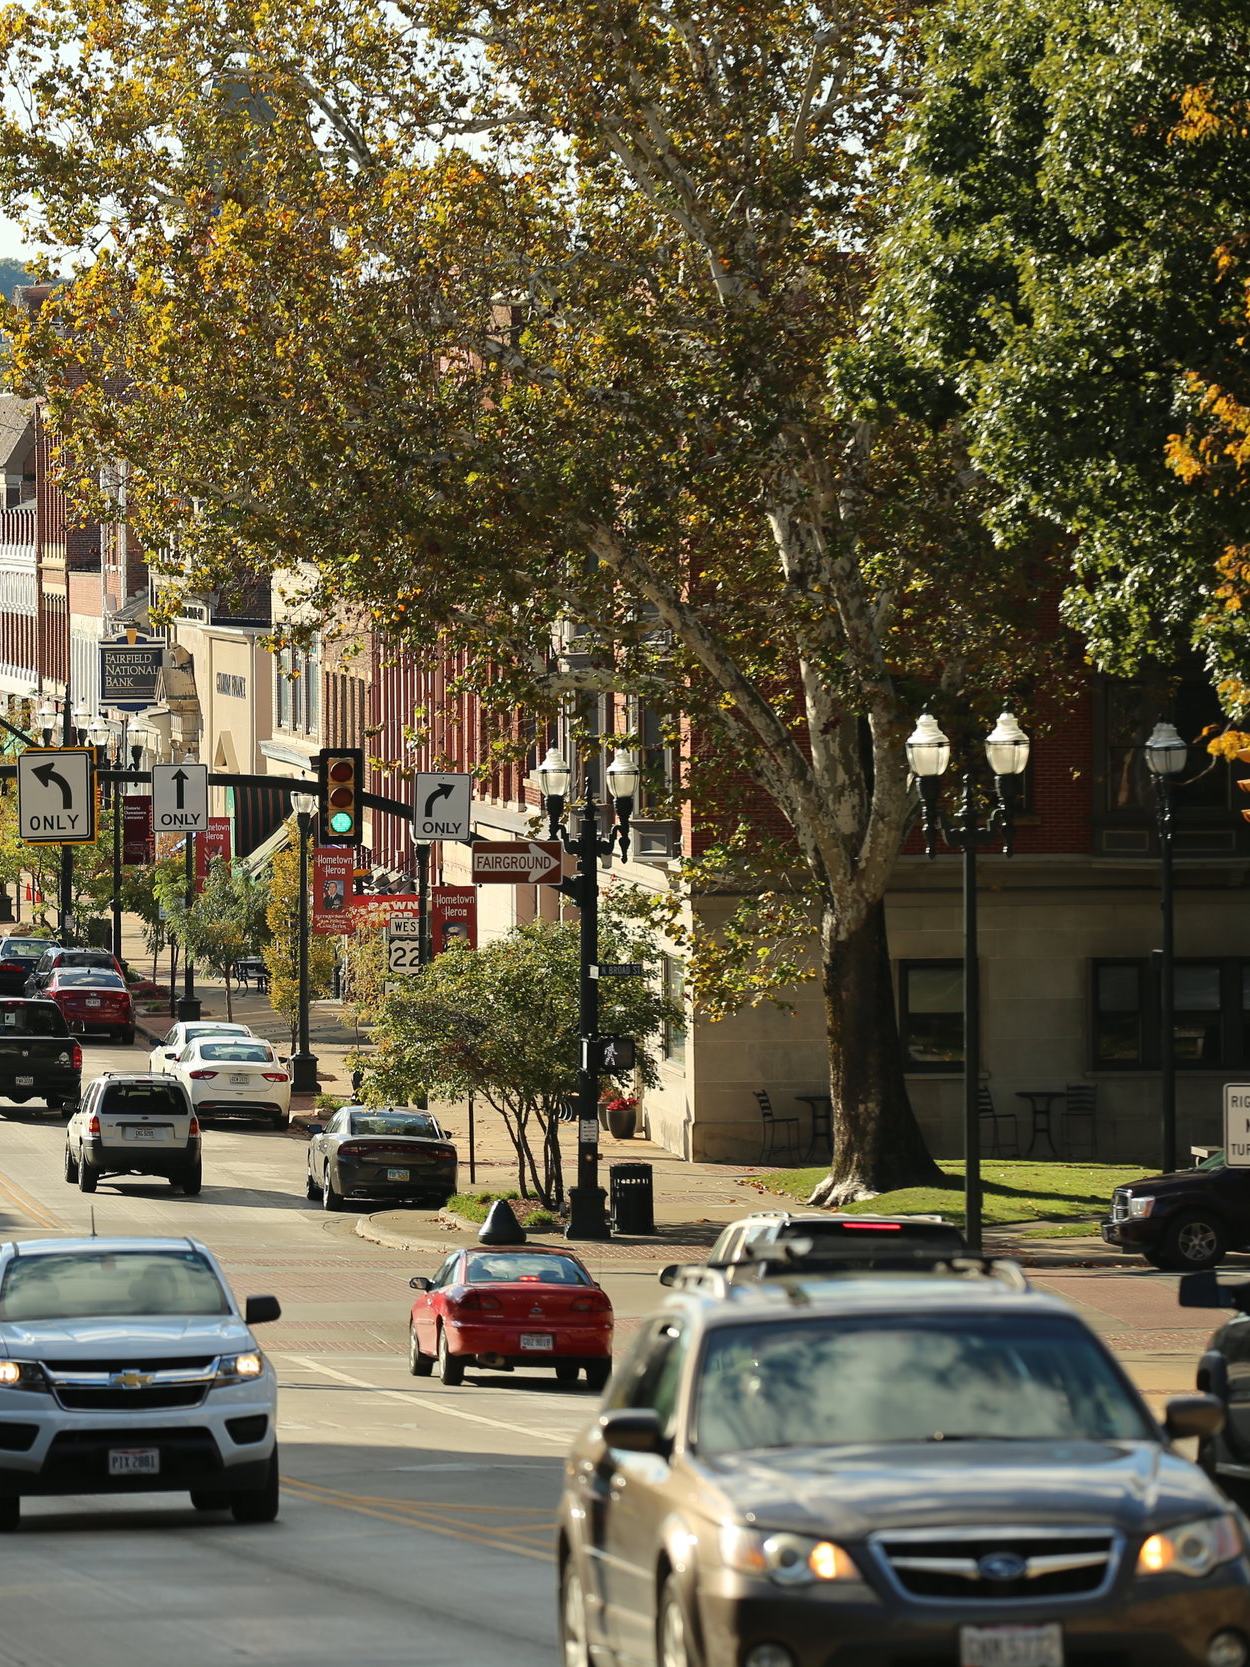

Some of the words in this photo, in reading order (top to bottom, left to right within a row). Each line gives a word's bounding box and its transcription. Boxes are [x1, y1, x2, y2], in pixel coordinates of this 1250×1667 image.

[105, 653, 152, 664] FAIRFIELD
[105, 665, 158, 675] NATIONAL
[105, 676, 134, 687] BANK
[29, 814, 80, 831] ONLY
[160, 813, 201, 826] ONLY
[422, 821, 462, 834] ONLY
[315, 855, 353, 867] Hometown
[477, 856, 551, 870] FAIRGROUND
[369, 901, 419, 910] PAWN
[434, 893, 475, 907] Hometown
[394, 922, 419, 932] WES
[392, 947, 419, 967] 22
[608, 965, 631, 975] BROAD
[632, 966, 641, 974] ST
[112, 1455, 130, 1469] PIX
